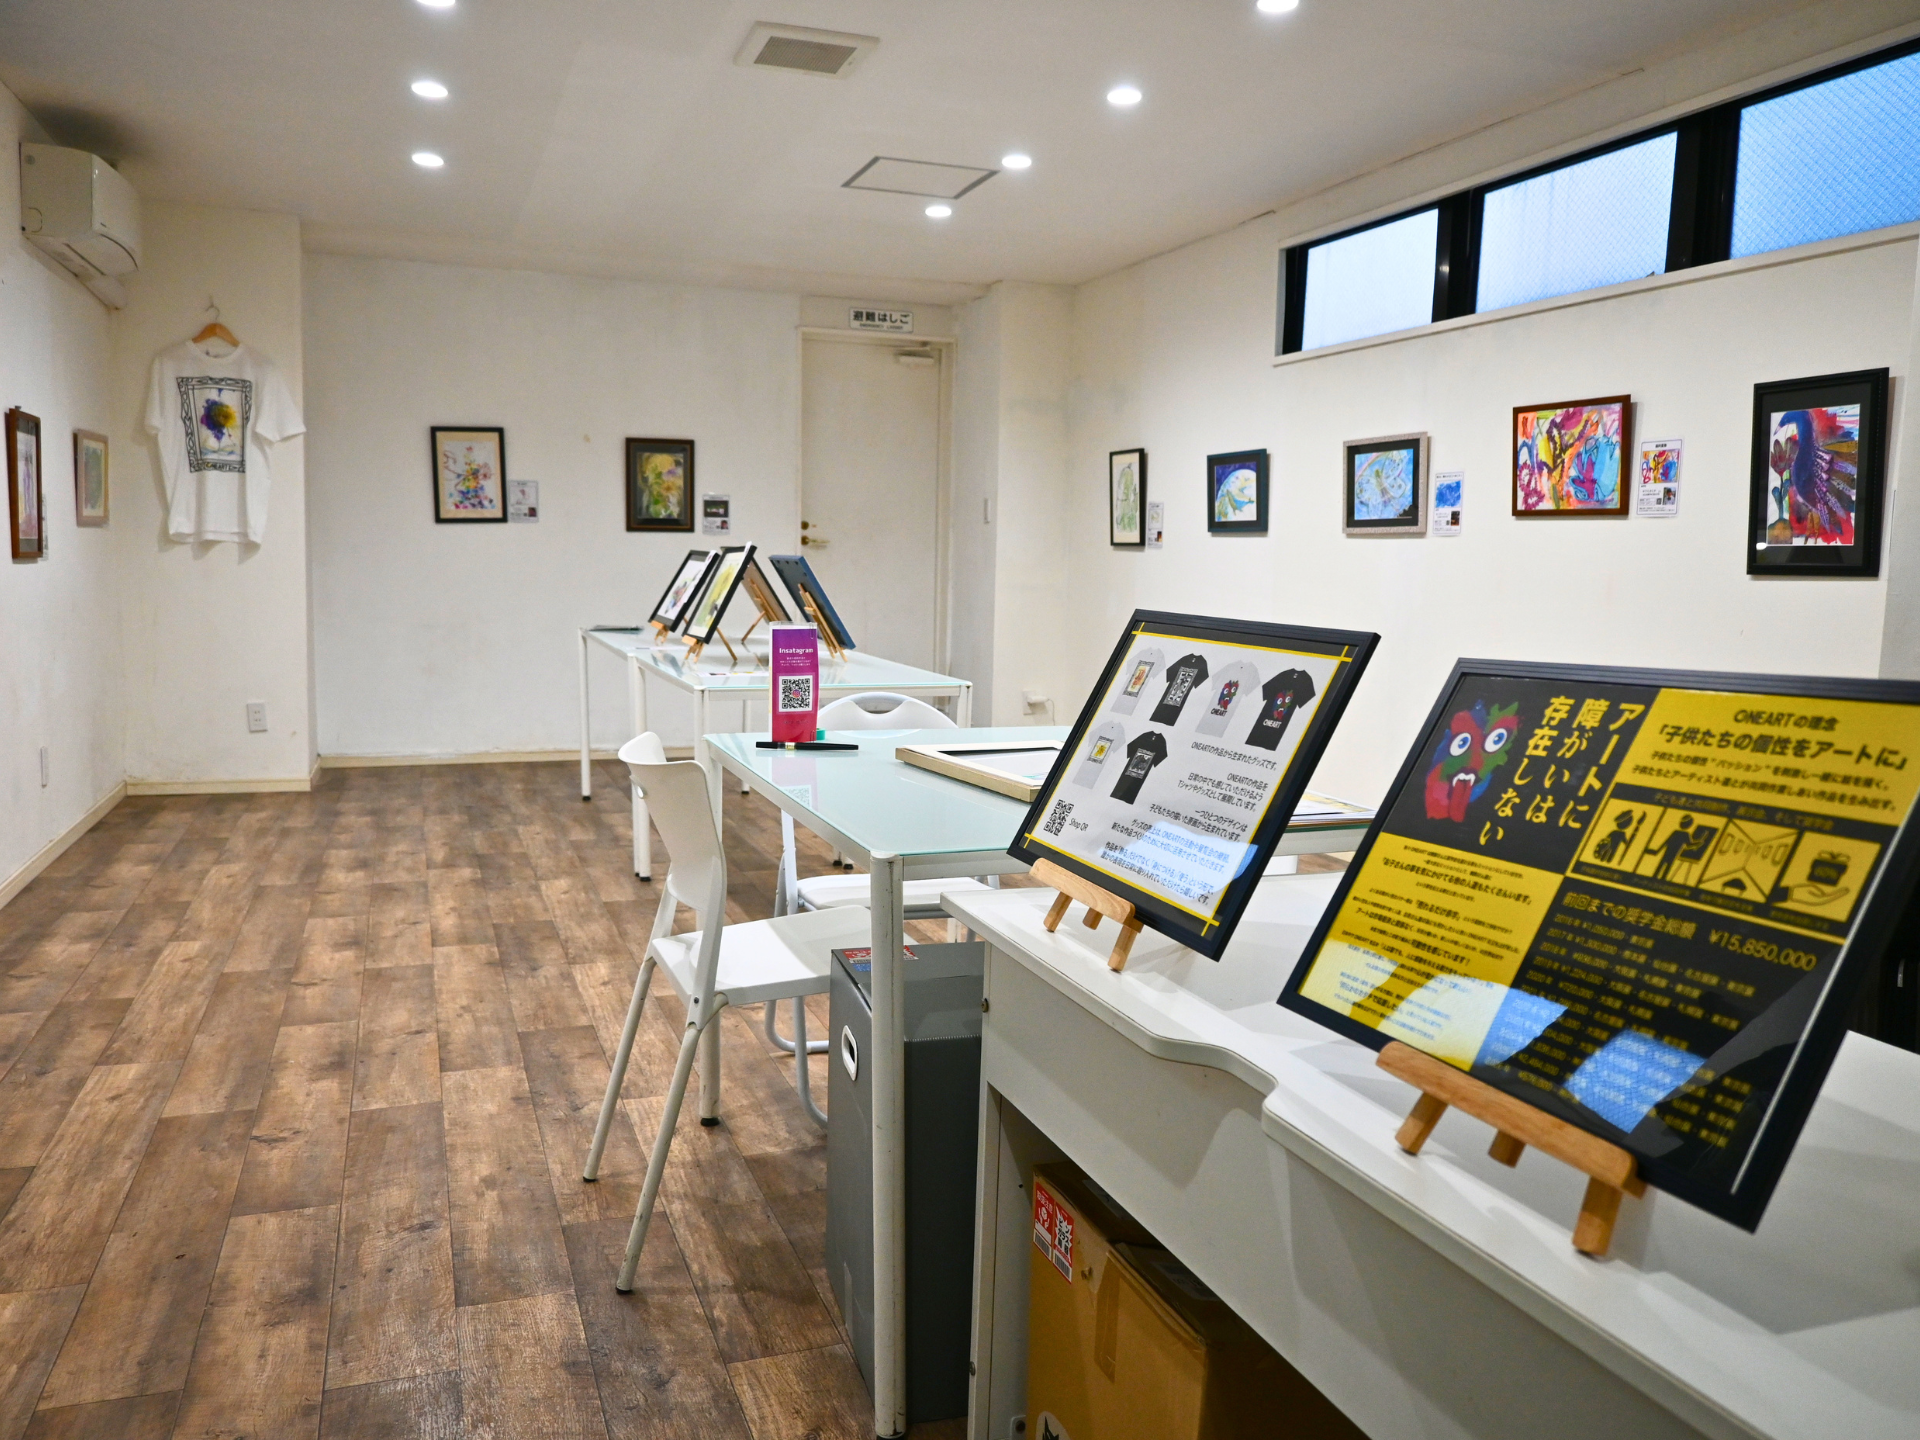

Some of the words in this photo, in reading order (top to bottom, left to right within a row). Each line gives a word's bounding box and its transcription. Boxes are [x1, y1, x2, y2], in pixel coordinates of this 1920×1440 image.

[853, 310, 910, 324] 避難はしご
[1210, 707, 1227, 716] ONEART
[1262, 718, 1281, 728] ONEART
[1659, 725, 1907, 770] 「子供たちの個性をアートに」
[1525, 698, 1607, 824] 障がいは
[1560, 701, 1643, 829] アートに
[1478, 696, 1568, 846] 存在しない
[1226, 773, 1268, 791] ONEARTの作品を
[1068, 817, 1081, 828] Shop
[1079, 822, 1088, 831] QR
